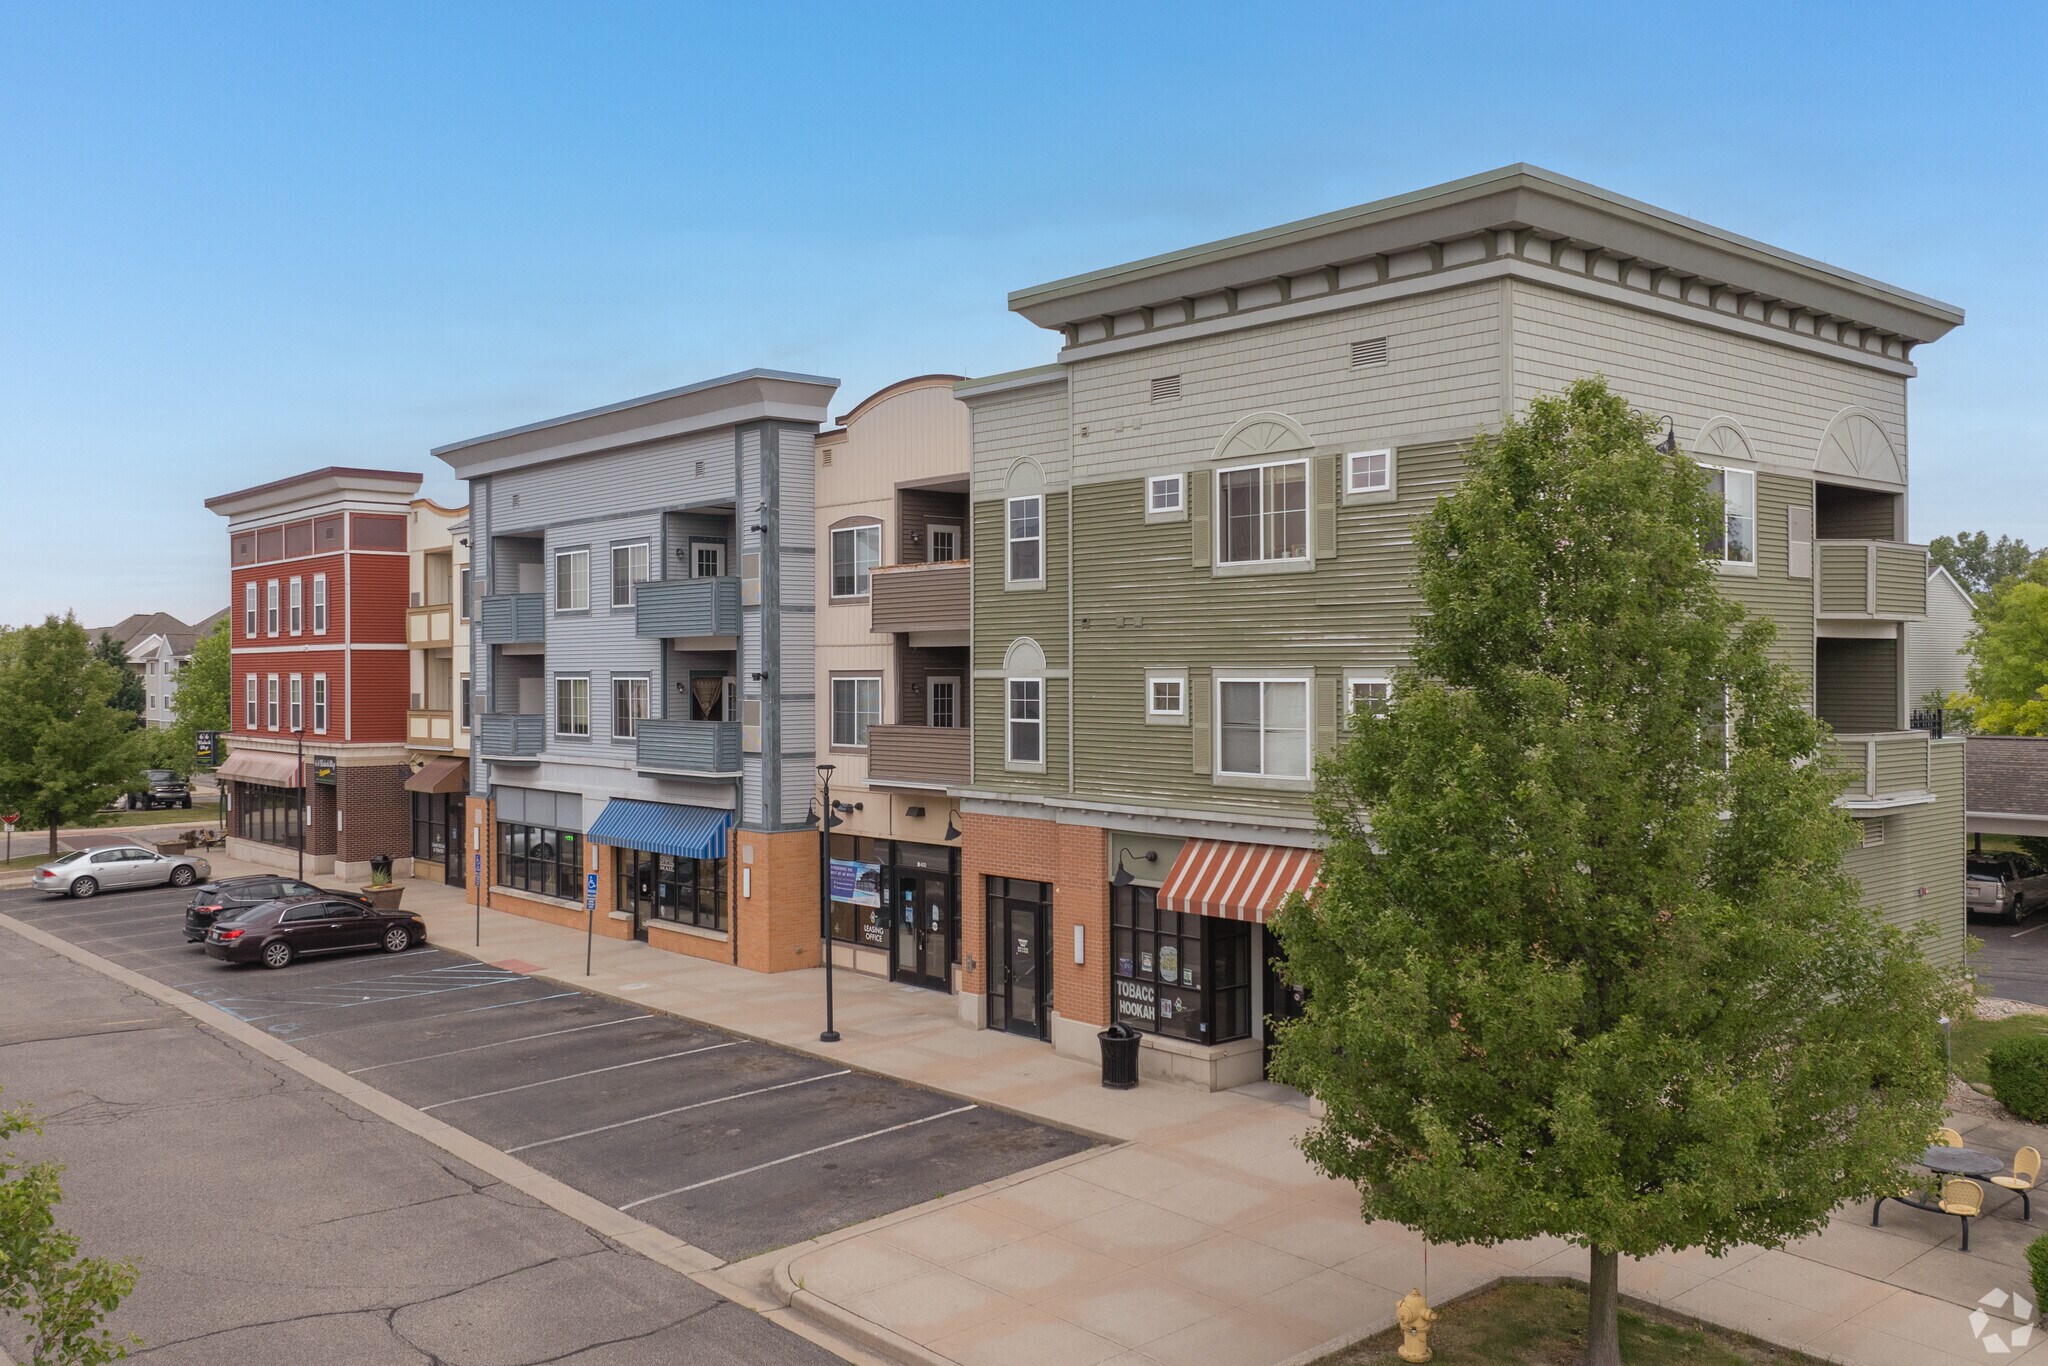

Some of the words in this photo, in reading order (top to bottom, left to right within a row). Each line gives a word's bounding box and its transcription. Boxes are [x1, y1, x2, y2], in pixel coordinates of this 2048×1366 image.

[864, 925, 884, 934] LEASING
[865, 933, 882, 942] OFFICE
[1119, 999, 1155, 1020] HOOKAH
